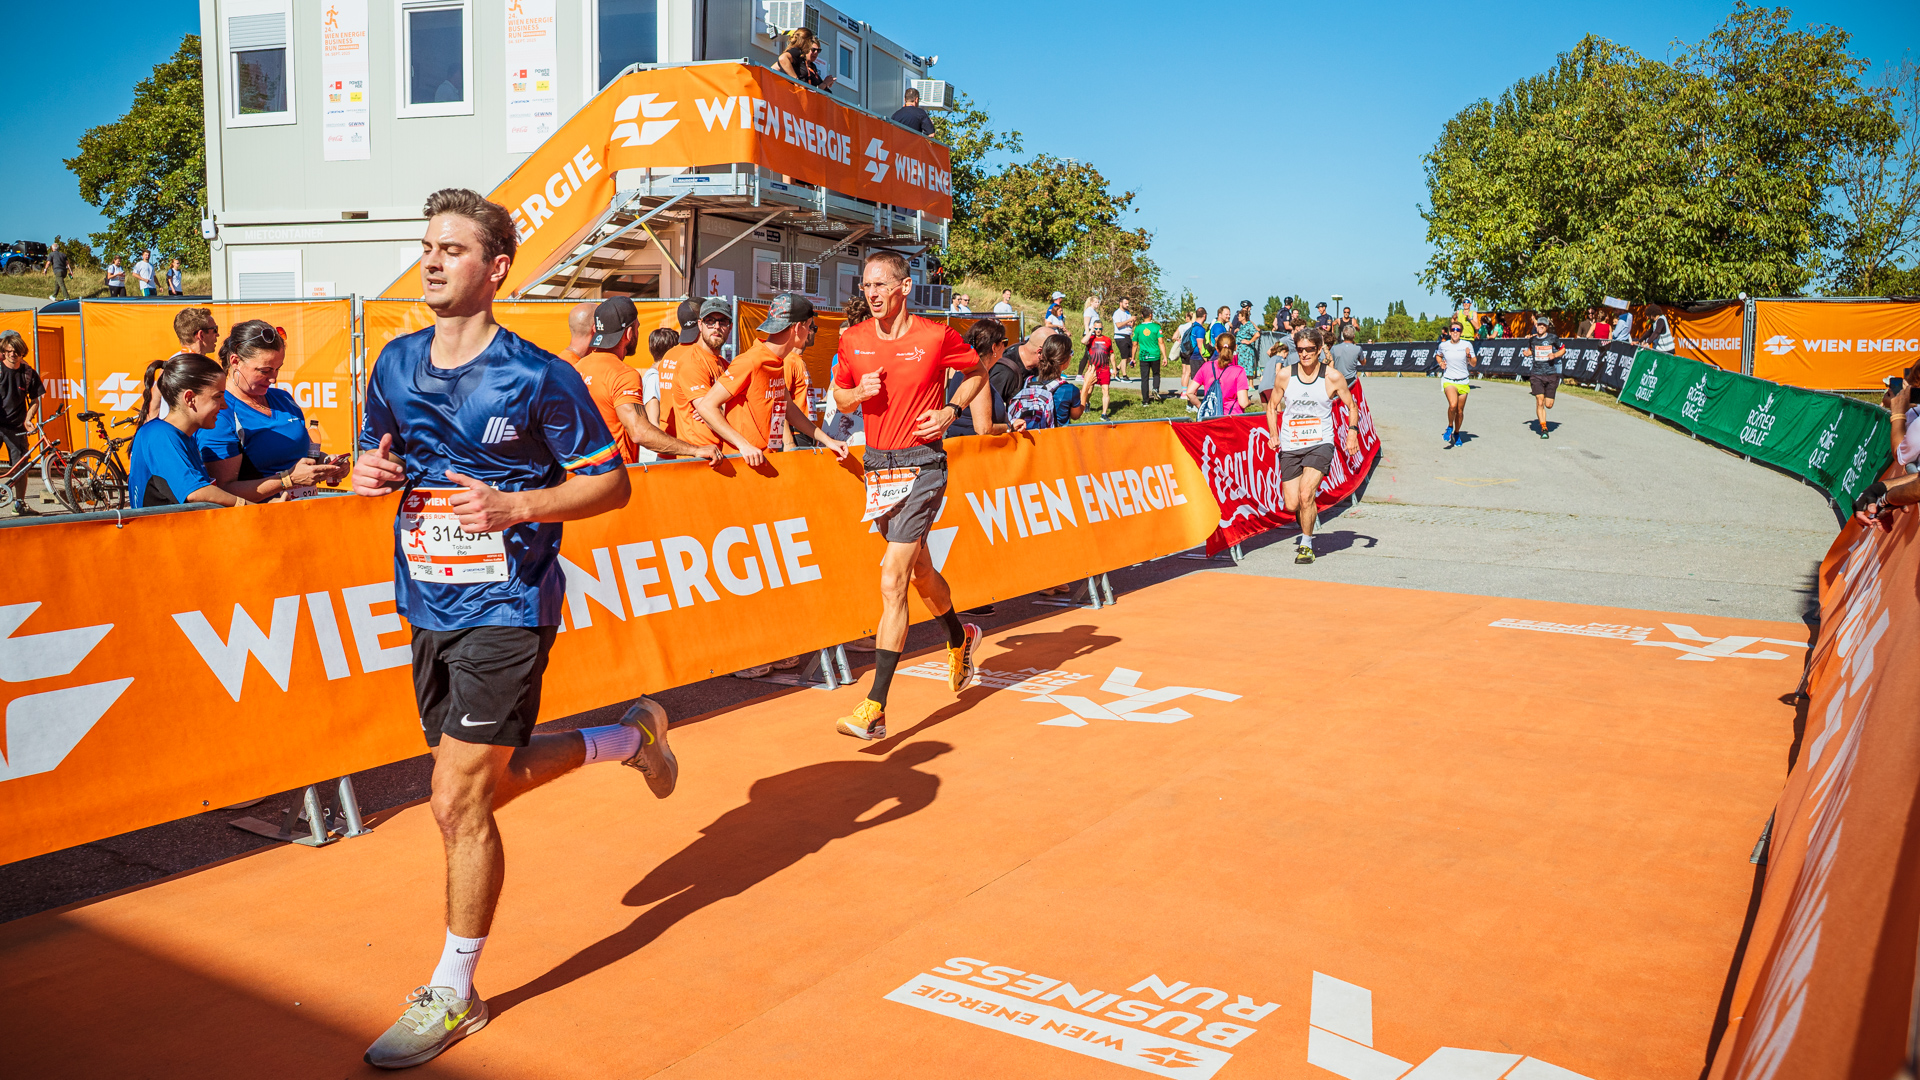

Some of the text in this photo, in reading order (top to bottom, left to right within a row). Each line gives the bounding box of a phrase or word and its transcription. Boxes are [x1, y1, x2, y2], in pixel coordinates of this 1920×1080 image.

[508, 24, 539, 32] BUSINESS
[694, 96, 851, 166] WIEN ENERGIE
[895, 152, 925, 187] WIEN
[244, 228, 324, 240] MIETCONTAINER
[1678, 337, 1741, 350] WIEN ENERGIE
[1803, 339, 1851, 353] WIEN
[1371, 350, 1387, 358] POWER
[1390, 350, 1407, 358] POWER
[1411, 350, 1429, 358] POWER
[1476, 347, 1495, 356] POWER
[1498, 347, 1515, 356] POWER
[423, 497, 447, 506] WIEN
[965, 463, 1188, 545] WIEN ENERGIE
[171, 516, 823, 703] WIE NERGIE
[1588, 622, 1656, 632] RUN
[1017, 666, 1094, 680] RUN
[930, 956, 1258, 1049] BUSINESS
[1126, 973, 1283, 1023] RUN
[911, 984, 1125, 1052] WIEN ENERGIE
